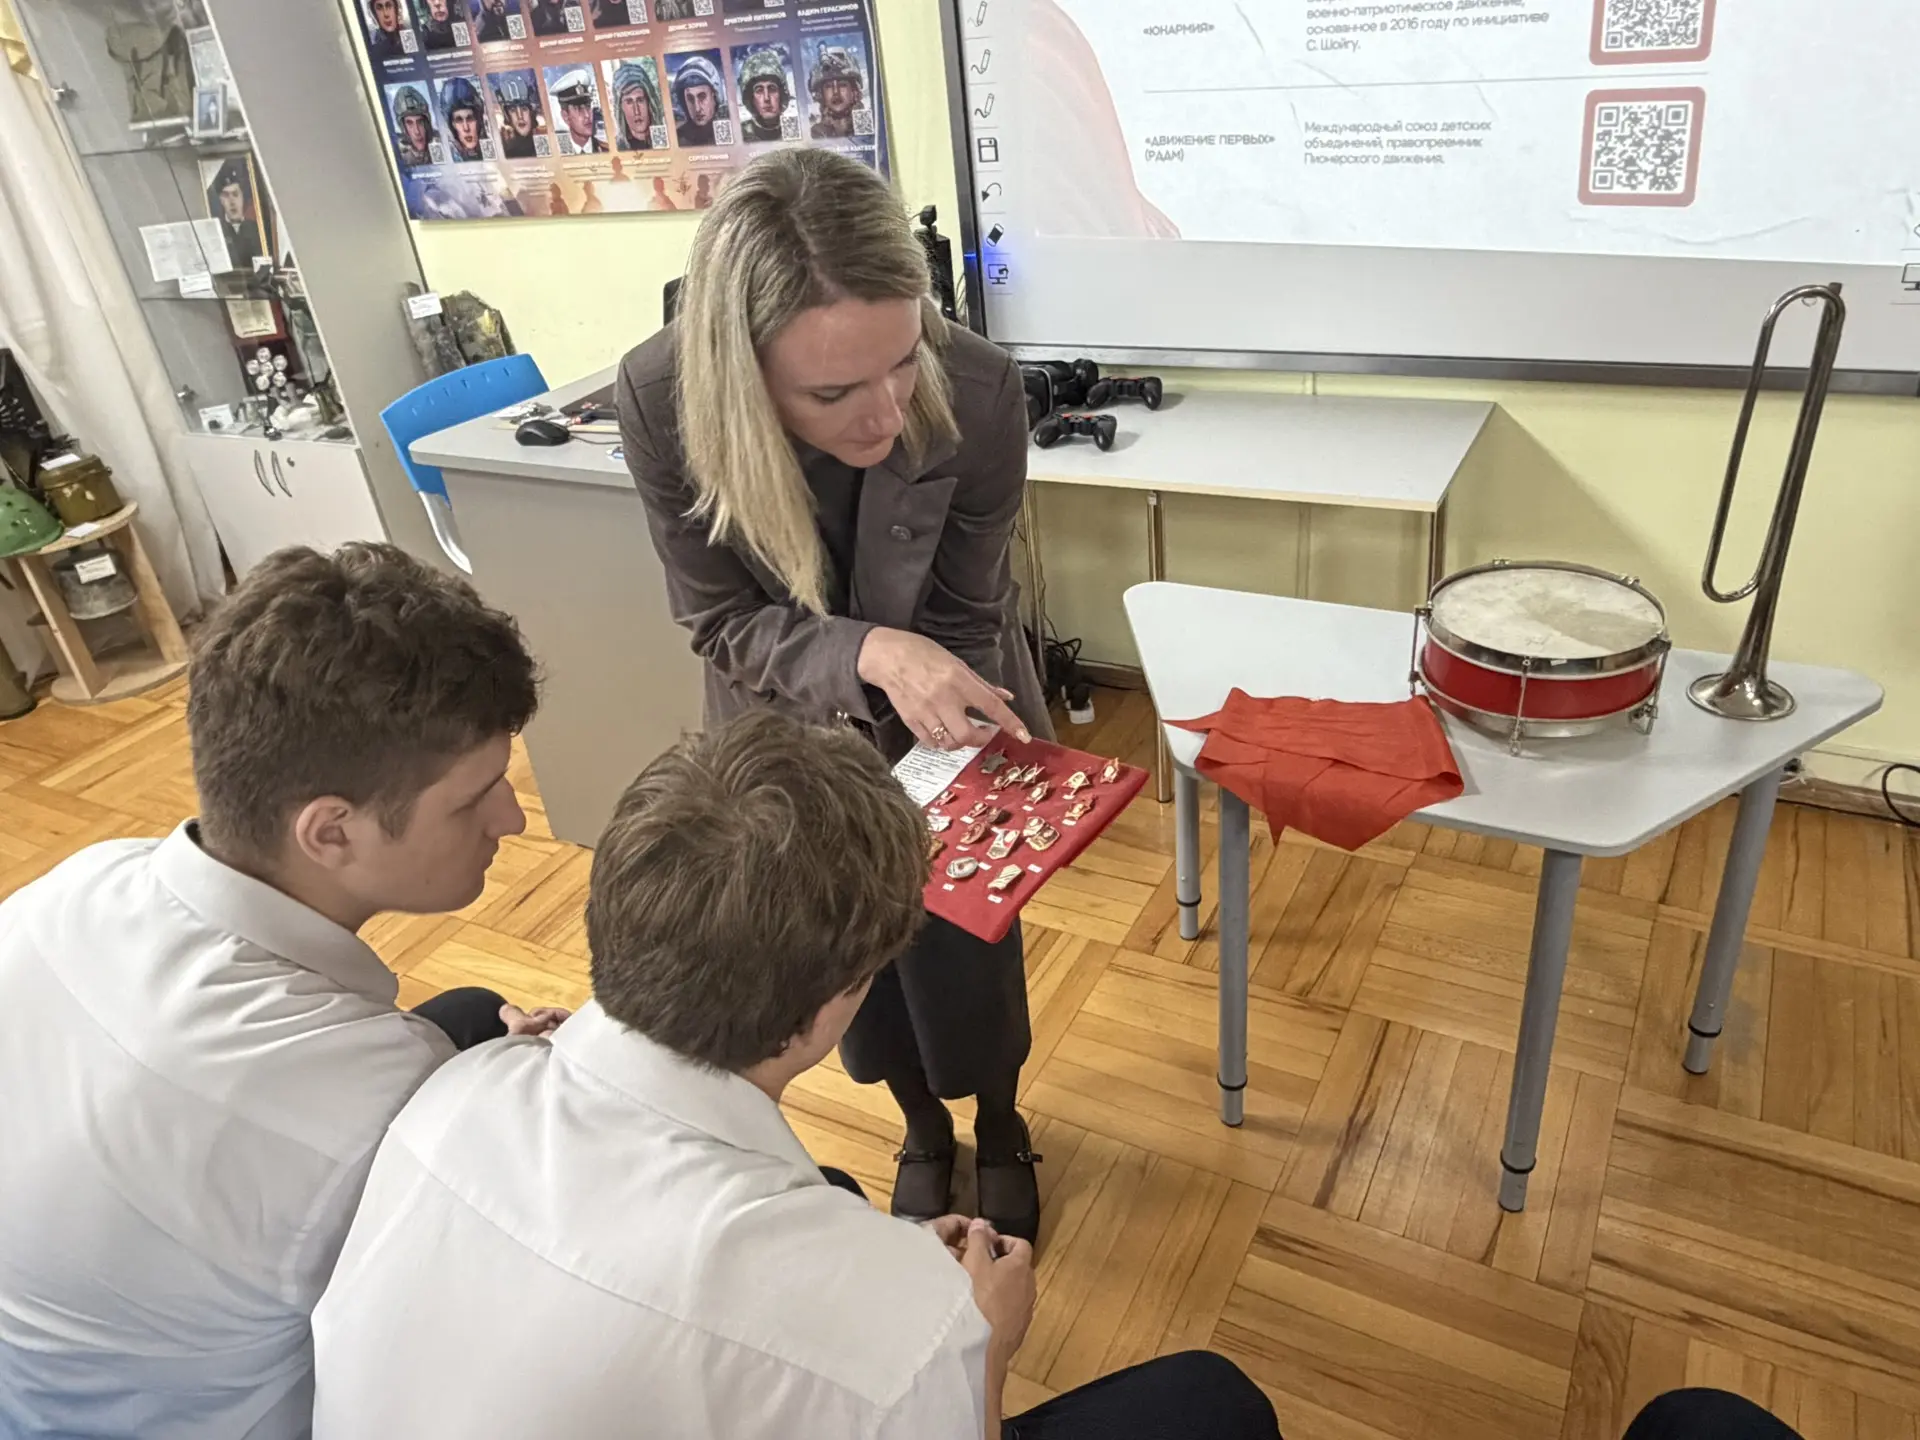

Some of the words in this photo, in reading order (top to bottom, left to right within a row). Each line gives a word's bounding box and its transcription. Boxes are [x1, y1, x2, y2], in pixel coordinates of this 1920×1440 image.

[1306, 3, 1454, 19] военно-патриотическое
[1143, 22, 1215, 36] «ЮНАРМИЯ»
[1306, 22, 1378, 36] основанное
[1379, 21, 1388, 32] в
[1389, 16, 1419, 31] 2016
[1420, 18, 1450, 31] году
[1452, 16, 1470, 28] по
[1472, 11, 1550, 27] инициативе
[1305, 38, 1319, 52] С.
[1320, 37, 1361, 53] Шойгу.
[1304, 120, 1402, 135] Международный
[1404, 122, 1438, 132] союз
[1439, 121, 1492, 132] детских
[1144, 134, 1216, 147] «ДВИЖЕНИЕ
[1218, 133, 1276, 146] ПЕРВЫХ»
[1144, 147, 1185, 162] (РДДМ)
[1304, 152, 1380, 166] Пионерского
